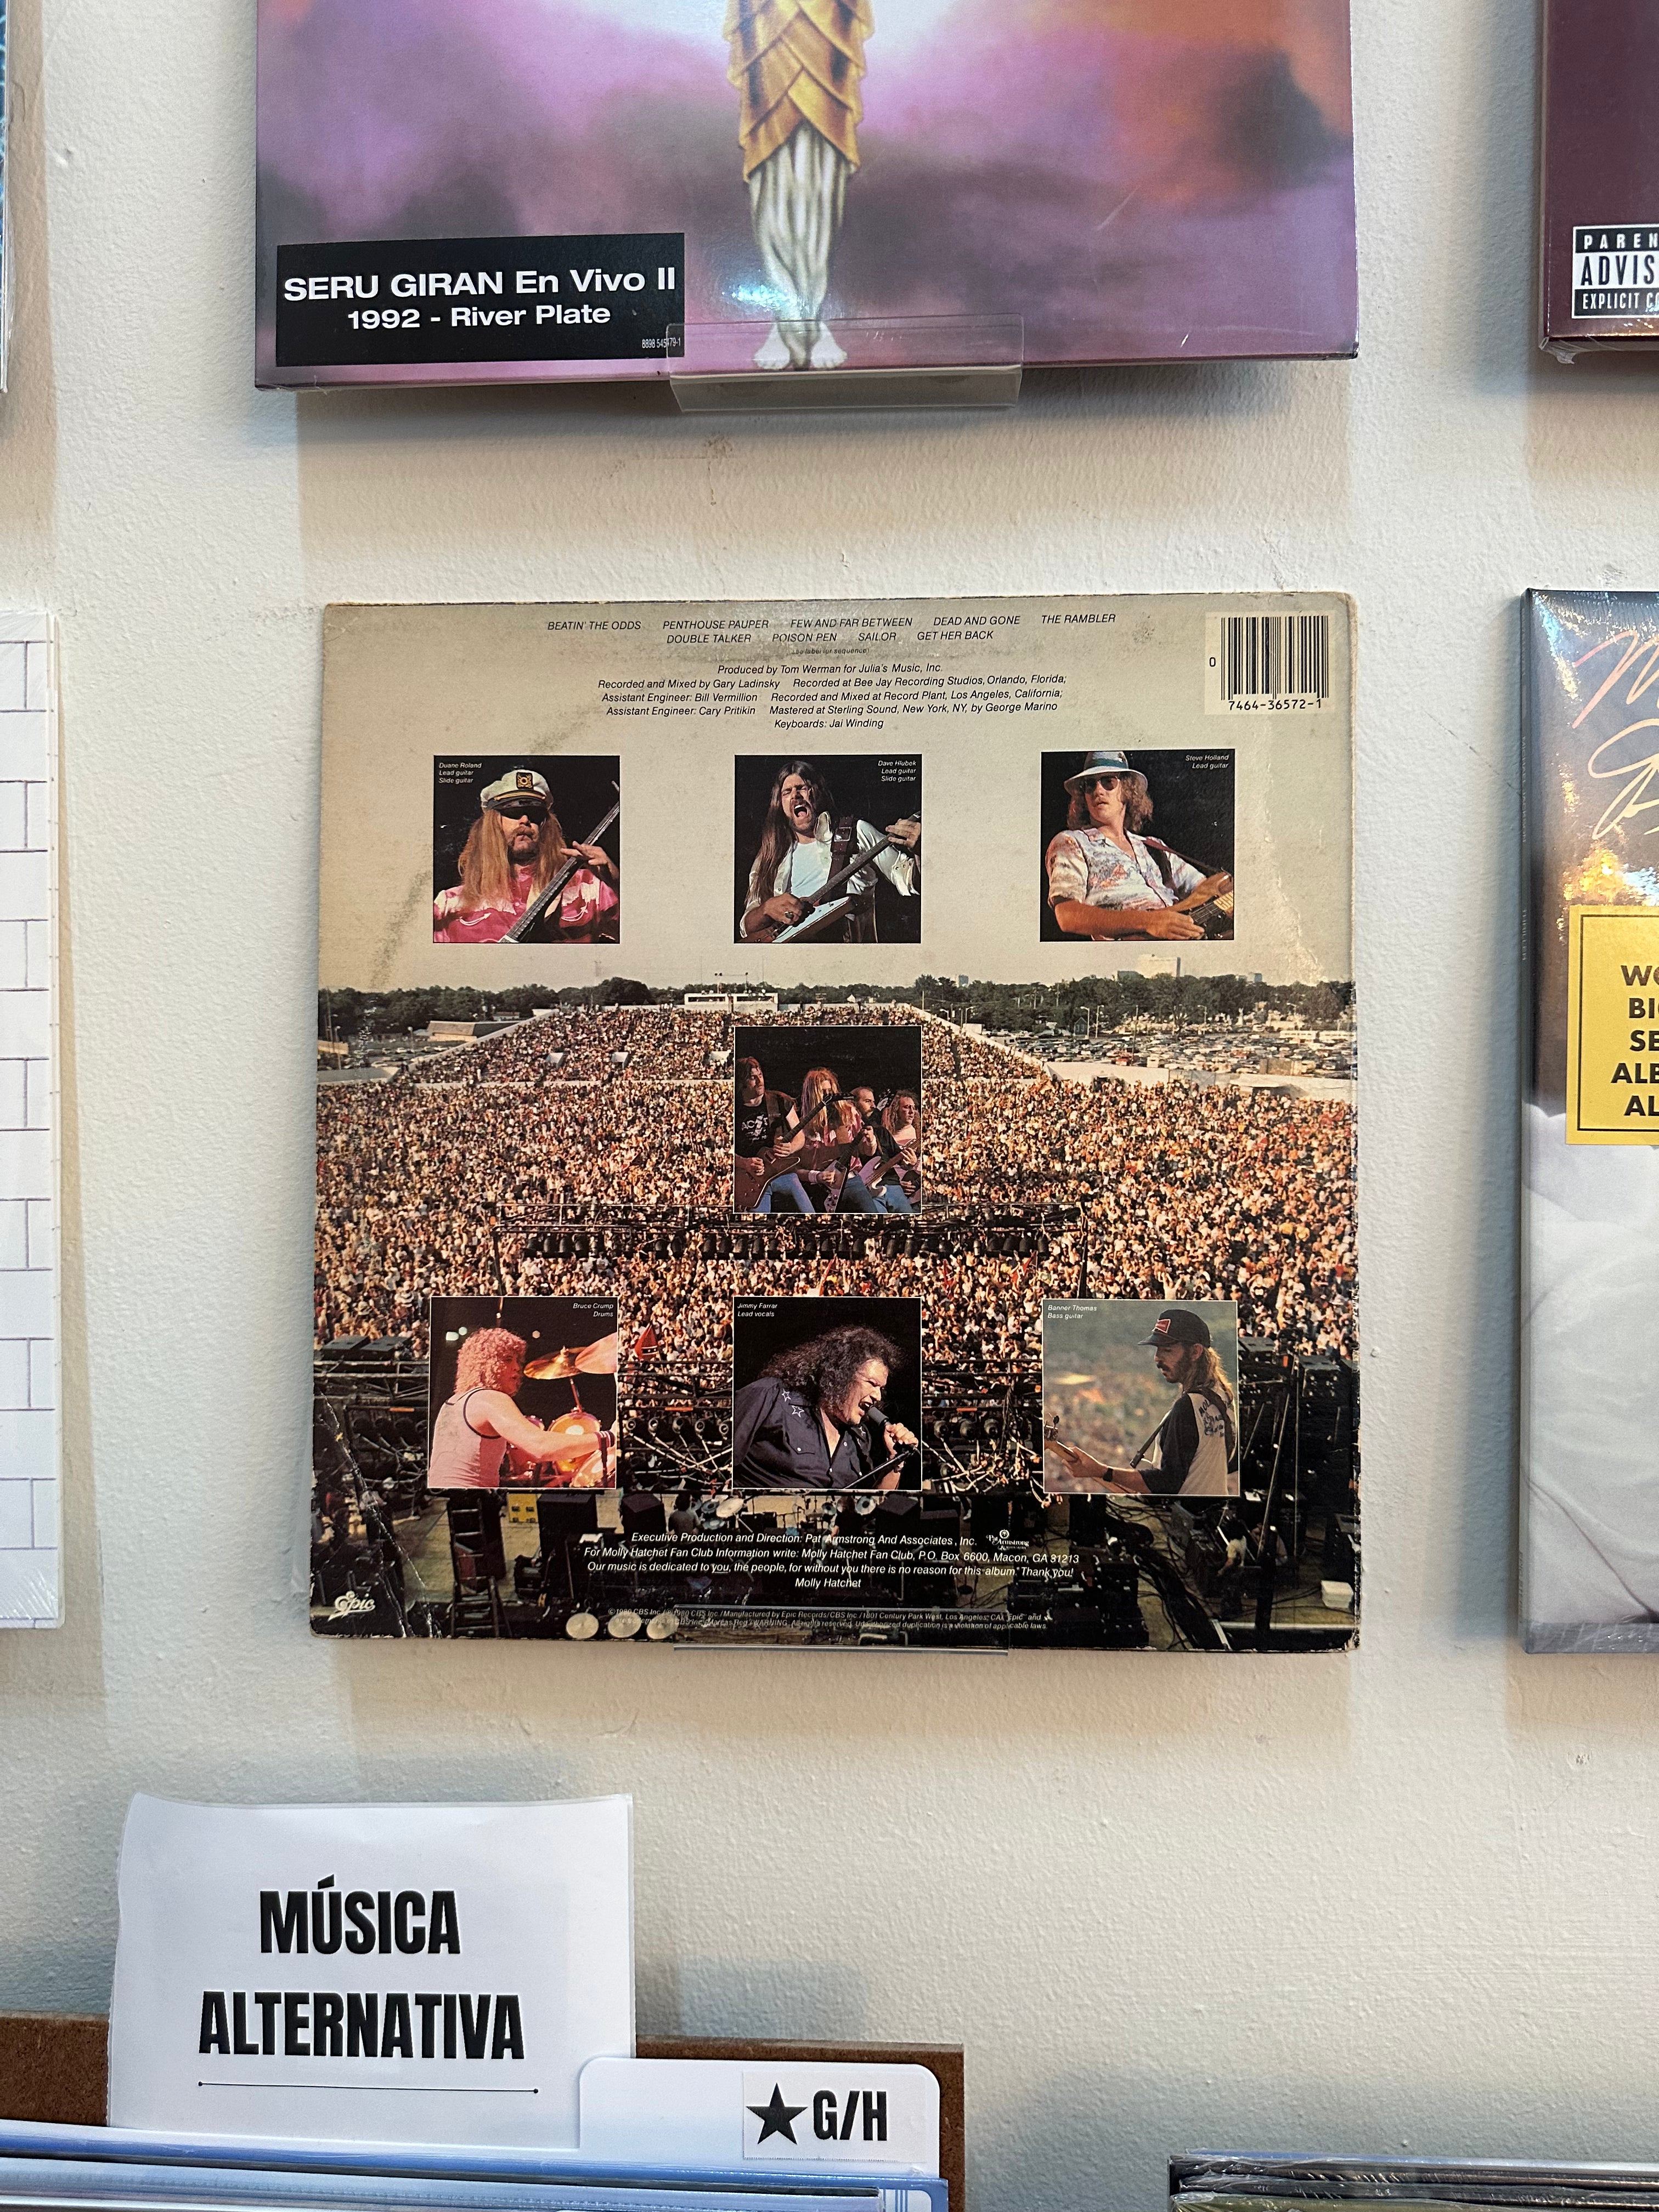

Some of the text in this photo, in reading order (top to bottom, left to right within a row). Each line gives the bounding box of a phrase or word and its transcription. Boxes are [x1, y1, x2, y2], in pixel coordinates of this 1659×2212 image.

[1584, 233, 1658, 250] PAREN
[1580, 255, 1655, 286] ADVIS
[285, 267, 674, 301] SERU GIRAN En Vivo II
[1582, 292, 1640, 309] EXPLICIT
[348, 309, 420, 329] 1992
[452, 307, 526, 326] River
[537, 304, 610, 324] Plate
[642, 338, 656, 348] 8898
[548, 621, 586, 630] BEATIN'
[612, 621, 641, 630] ODDS
[663, 620, 725, 629] PENTHOUSE
[729, 620, 769, 629] PAUPER
[790, 619, 812, 628] FEW
[815, 619, 837, 628] AND
[840, 618, 859, 627] FAR
[862, 618, 912, 627] BETWEEN
[934, 617, 962, 625] DEAD
[964, 617, 986, 625] AND
[990, 616, 1020, 625] GONE
[1042, 615, 1061, 623] THE
[1064, 614, 1116, 623] RAMBLER
[667, 630, 994, 644] DOUBLE TALKER POISON PEN SAILOR GET HER BACK
[718, 663, 943, 676] Produced by Tom Werman for Julia's Music, Inc.
[1209, 657, 1216, 667] 0
[598, 680, 645, 689] Recorded
[647, 680, 665, 688] and
[668, 680, 697, 688] Mixed
[699, 680, 710, 690] by
[713, 679, 735, 690] Gary
[738, 679, 780, 690] Ladinsky
[793, 679, 840, 687] Recorded
[854, 678, 873, 686] Bee
[876, 678, 892, 688] Jay
[895, 677, 944, 687] Recording
[947, 676, 984, 685] Studios,
[988, 675, 1027, 685] Orlando,
[1031, 674, 1066, 684] Florida;
[602, 693, 645, 702] Assistant
[647, 693, 692, 703] Engineer:
[695, 693, 709, 702] Bill
[713, 693, 757, 702] Vermillion
[771, 693, 818, 701] Recorded
[820, 692, 838, 701] and
[841, 692, 870, 701] Mixed
[884, 691, 919, 700] Record
[922, 691, 947, 700] Plant,
[951, 691, 968, 699] Los
[970, 690, 1011, 701] Angeles,
[1015, 689, 1063, 698] California;
[1228, 698, 1321, 710] 7464-36572-1
[606, 707, 650, 715] Assistant
[652, 707, 697, 717] Engineer:
[699, 707, 721, 716] Cary
[724, 706, 755, 714] Pritikin
[770, 706, 814, 714] Mastered
[828, 706, 864, 715] Sterling
[867, 705, 899, 714] Sound,
[903, 704, 924, 713] New
[928, 704, 949, 714] York,
[952, 703, 967, 713] NY,
[971, 703, 983, 714] by
[986, 703, 1021, 713] George
[1024, 702, 1057, 710] Marino
[631, 1533, 678, 1542] Executive
[681, 1533, 733, 1543] Production
[736, 1533, 754, 1542] and
[757, 1533, 803, 1543] Direction:
[805, 1534, 821, 1543] Pat
[825, 1534, 875, 1545] Armstrong
[878, 1535, 897, 1544] And
[960, 1537, 977, 1545] Inc.
[584, 1547, 601, 1556] For
[603, 1548, 628, 1559] Molly
[630, 1548, 668, 1558] Hatchet
[670, 1548, 688, 1557] Fan
[691, 1548, 713, 1558] Club
[716, 1548, 769, 1558] Information
[773, 1549, 799, 1558] write:
[802, 1549, 827, 1560] Molly
[830, 1550, 867, 1559] Hatchet
[870, 1550, 888, 1559] Fan
[891, 1550, 915, 1561] Club,
[941, 1551, 959, 1560] Box
[963, 1552, 990, 1562] 6600,
[994, 1553, 1029, 1563] Macon,
[1032, 1554, 1047, 1562] GA
[588, 1562, 606, 1571] Our
[608, 1563, 636, 1571] music
[639, 1562, 647, 1571] is
[650, 1562, 698, 1571] dedicated
[701, 1563, 709, 1571] to
[712, 1565, 731, 1573] you,
[734, 1563, 748, 1572] the
[751, 1564, 786, 1574] people,
[789, 1563, 802, 1572] for
[805, 1564, 839, 1573] without
[842, 1566, 858, 1576] you
[861, 1565, 885, 1573] there
[888, 1565, 896, 1573] is
[949, 1566, 962, 1575] for
[964, 1566, 981, 1575] this
[1022, 1567, 1049, 1576] Thank
[1052, 1568, 1074, 1578] you!
[328, 1591, 376, 1621] Epic
[260, 1874, 461, 1954] MÚSICA
[199, 1990, 524, 2060] ALTERNATIVA
[813, 2090, 888, 2142] G/H
